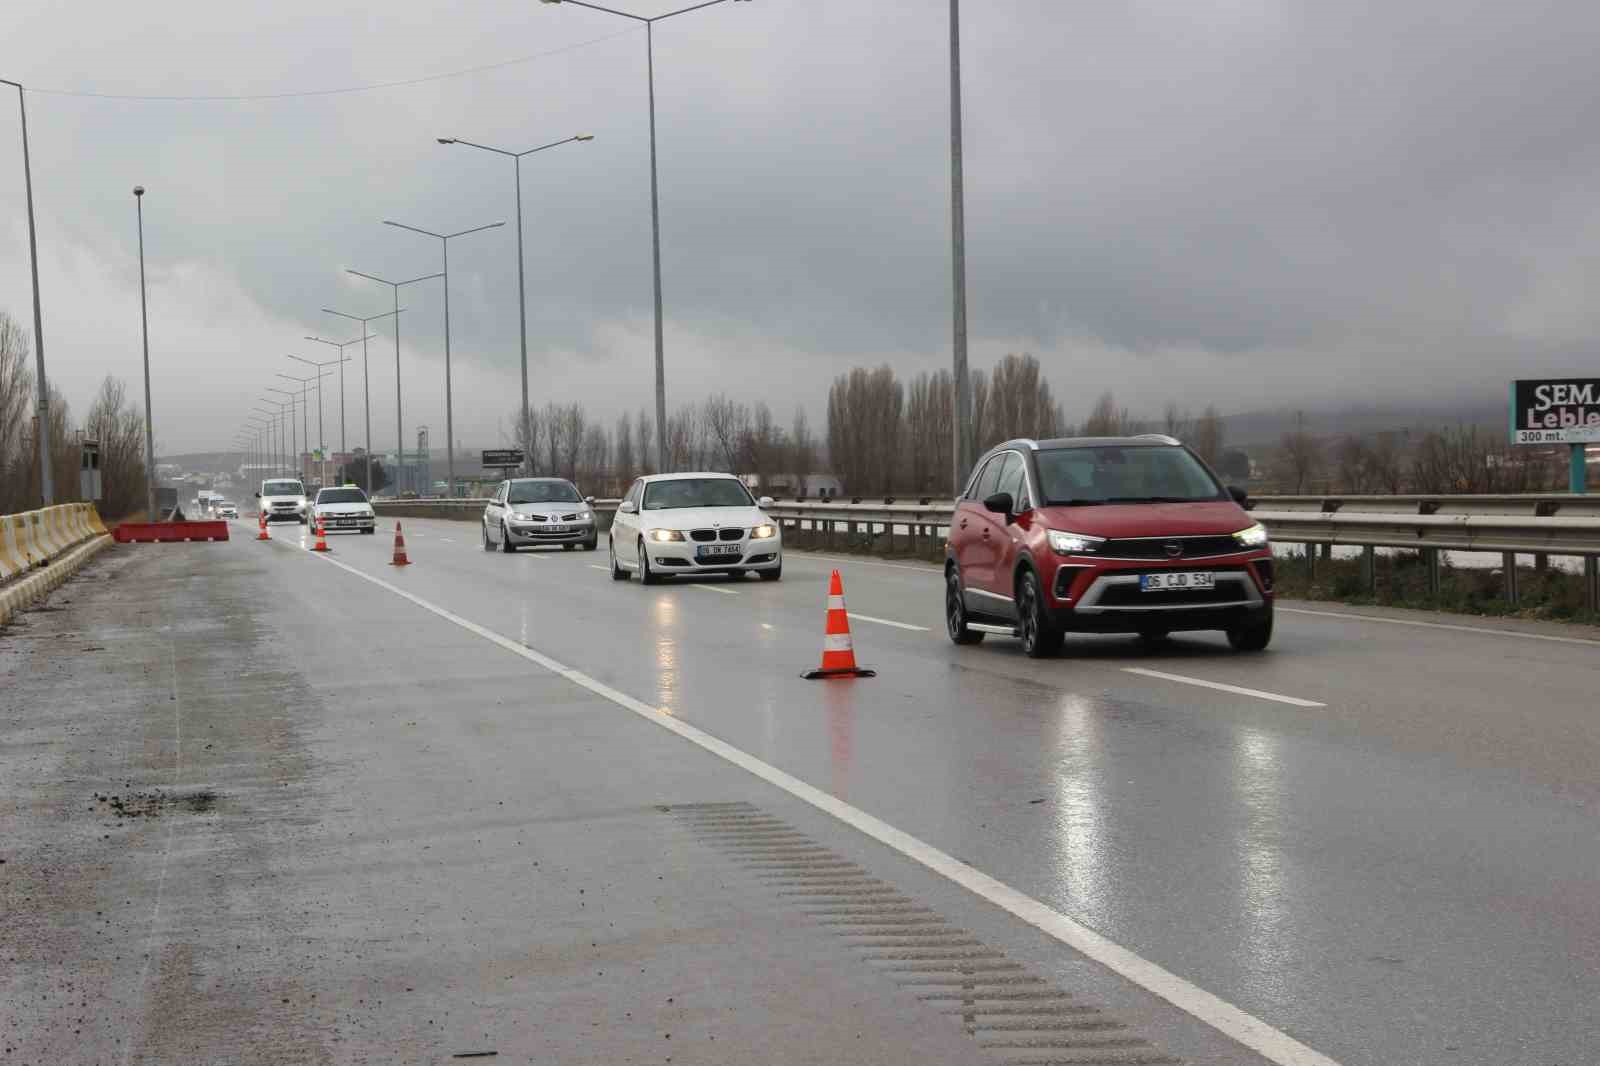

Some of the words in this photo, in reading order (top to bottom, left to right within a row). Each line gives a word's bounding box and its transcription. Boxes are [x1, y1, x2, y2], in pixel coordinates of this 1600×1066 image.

[1535, 384, 1600, 411] SEM
[1527, 407, 1600, 428] Leble
[1521, 432, 1541, 442] 300
[1545, 432, 1564, 441] mt.
[1147, 575, 1161, 587] 06
[1193, 573, 1213, 586] 534
